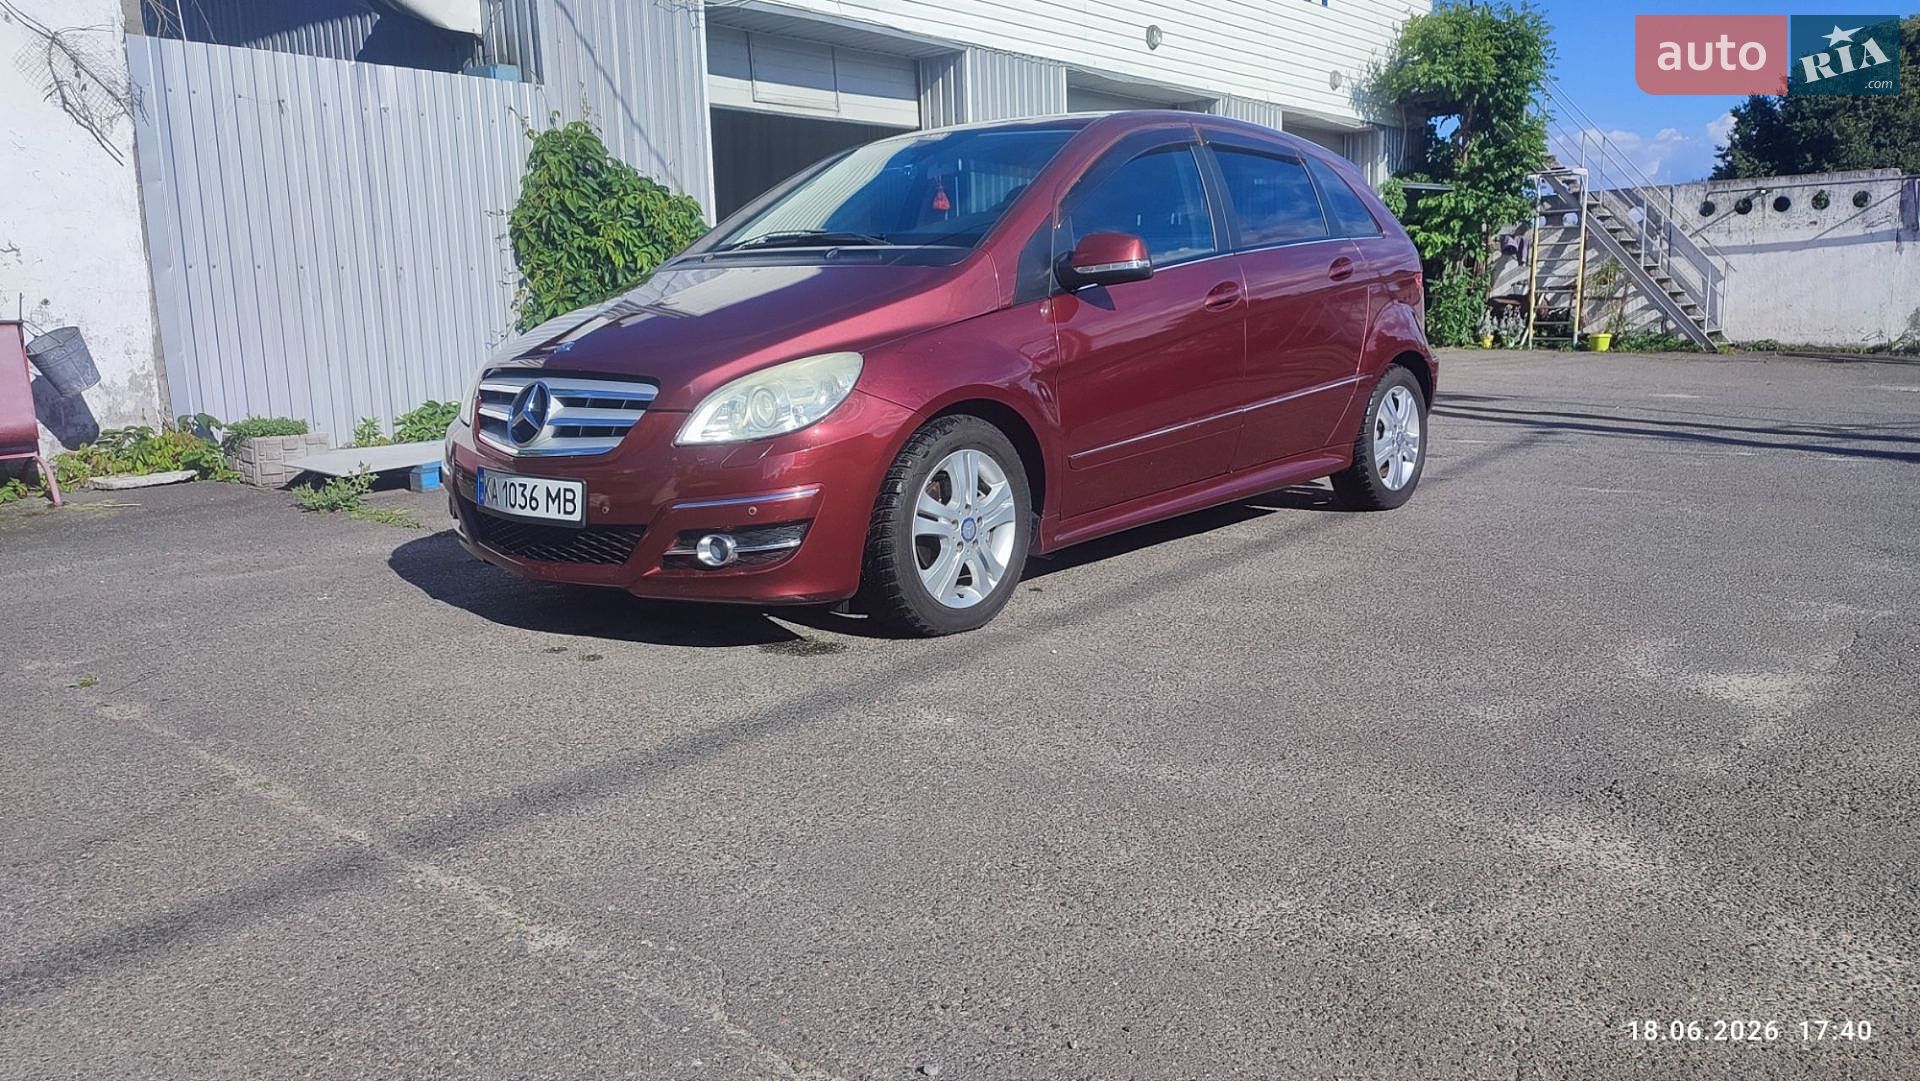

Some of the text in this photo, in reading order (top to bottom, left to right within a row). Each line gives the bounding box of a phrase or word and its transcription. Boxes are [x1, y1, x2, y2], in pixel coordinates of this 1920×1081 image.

[484, 477, 577, 515] KA 1036 MB
